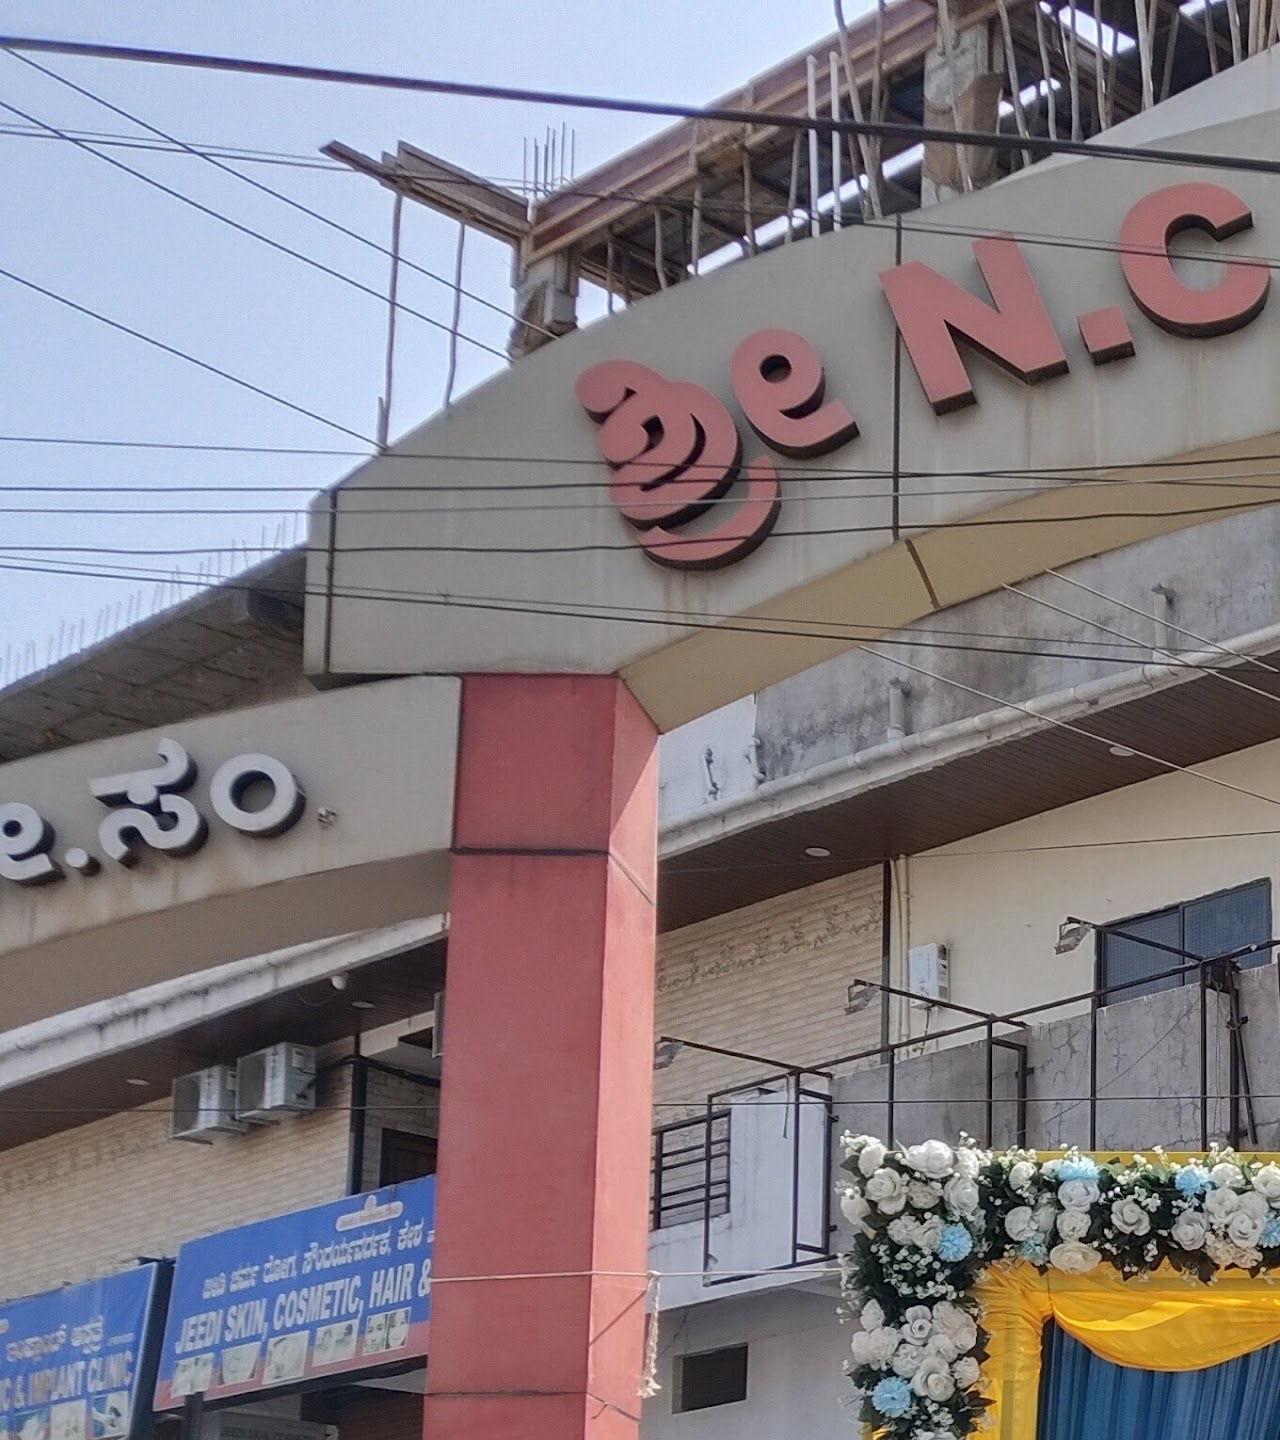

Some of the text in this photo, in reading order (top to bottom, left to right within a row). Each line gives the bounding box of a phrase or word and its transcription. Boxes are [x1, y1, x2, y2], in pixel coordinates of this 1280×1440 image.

[574, 329, 859, 570] ಶ್ರೀ
[175, 1258, 431, 1354] JEEDI SKIN, COSMETIC, HAIR &
